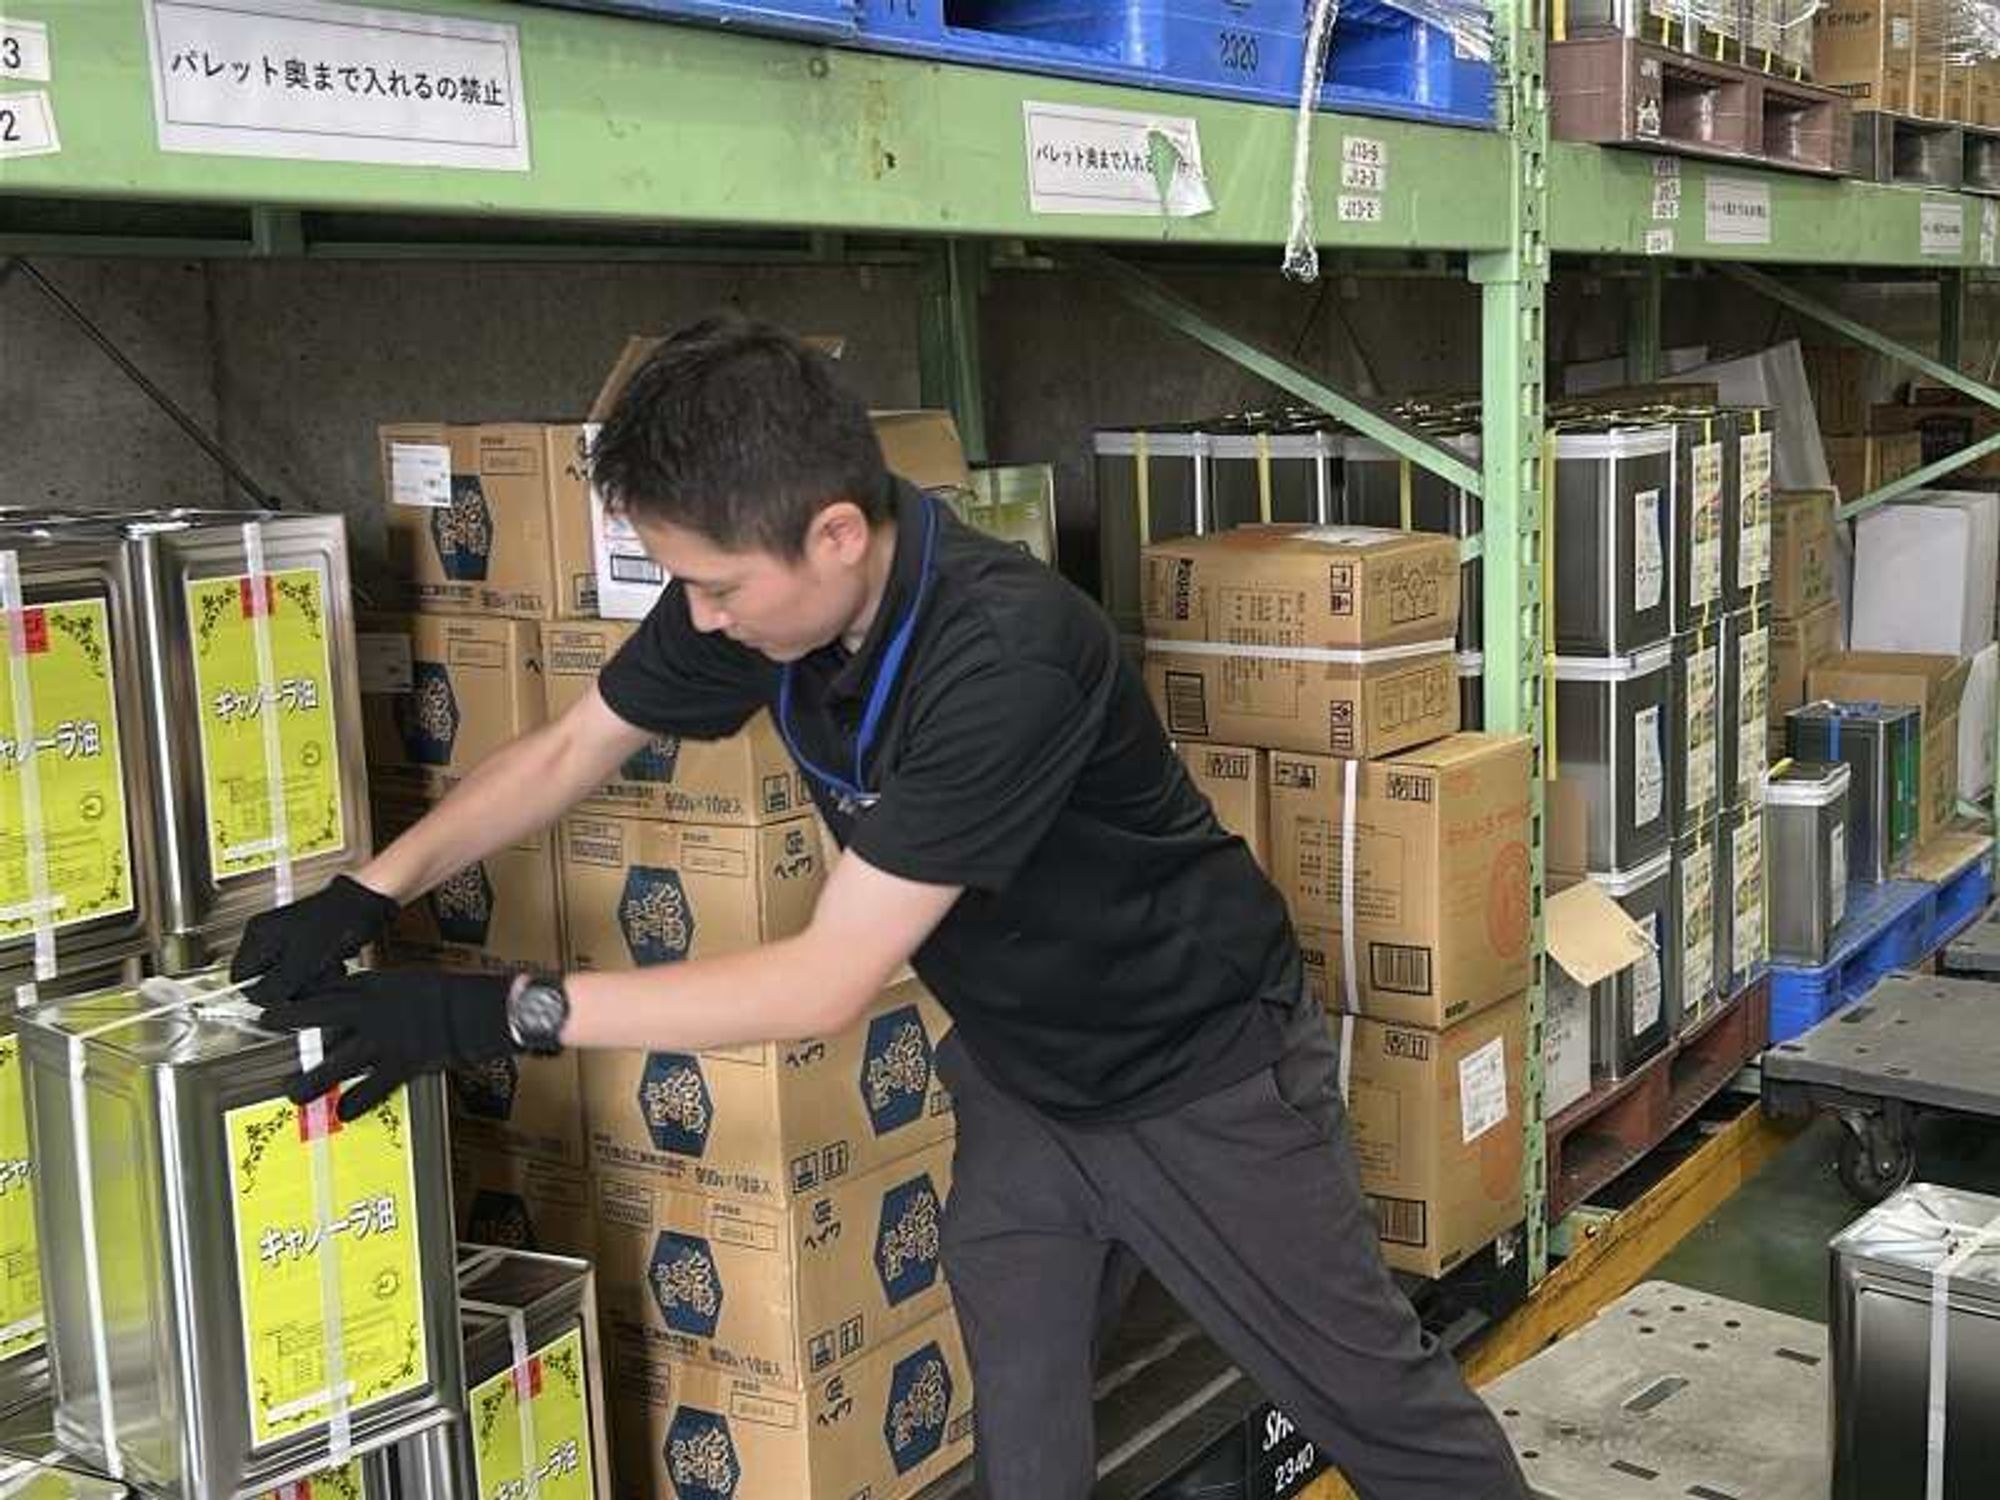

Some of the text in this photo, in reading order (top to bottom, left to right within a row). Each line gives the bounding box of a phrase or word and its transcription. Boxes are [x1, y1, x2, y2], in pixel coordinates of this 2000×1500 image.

[3, 36, 21, 69] 3
[172, 49, 505, 106] パレット奥まで入れるの禁止
[0, 109, 21, 142] 2
[213, 678, 320, 725] キャノーラ油
[773, 857, 815, 883] ヘイワ
[784, 1042, 825, 1069] ヘイワ
[258, 1192, 399, 1265] キャノーラ油
[804, 1223, 843, 1251] ヘイワ
[816, 1400, 853, 1428] ヘイワ
